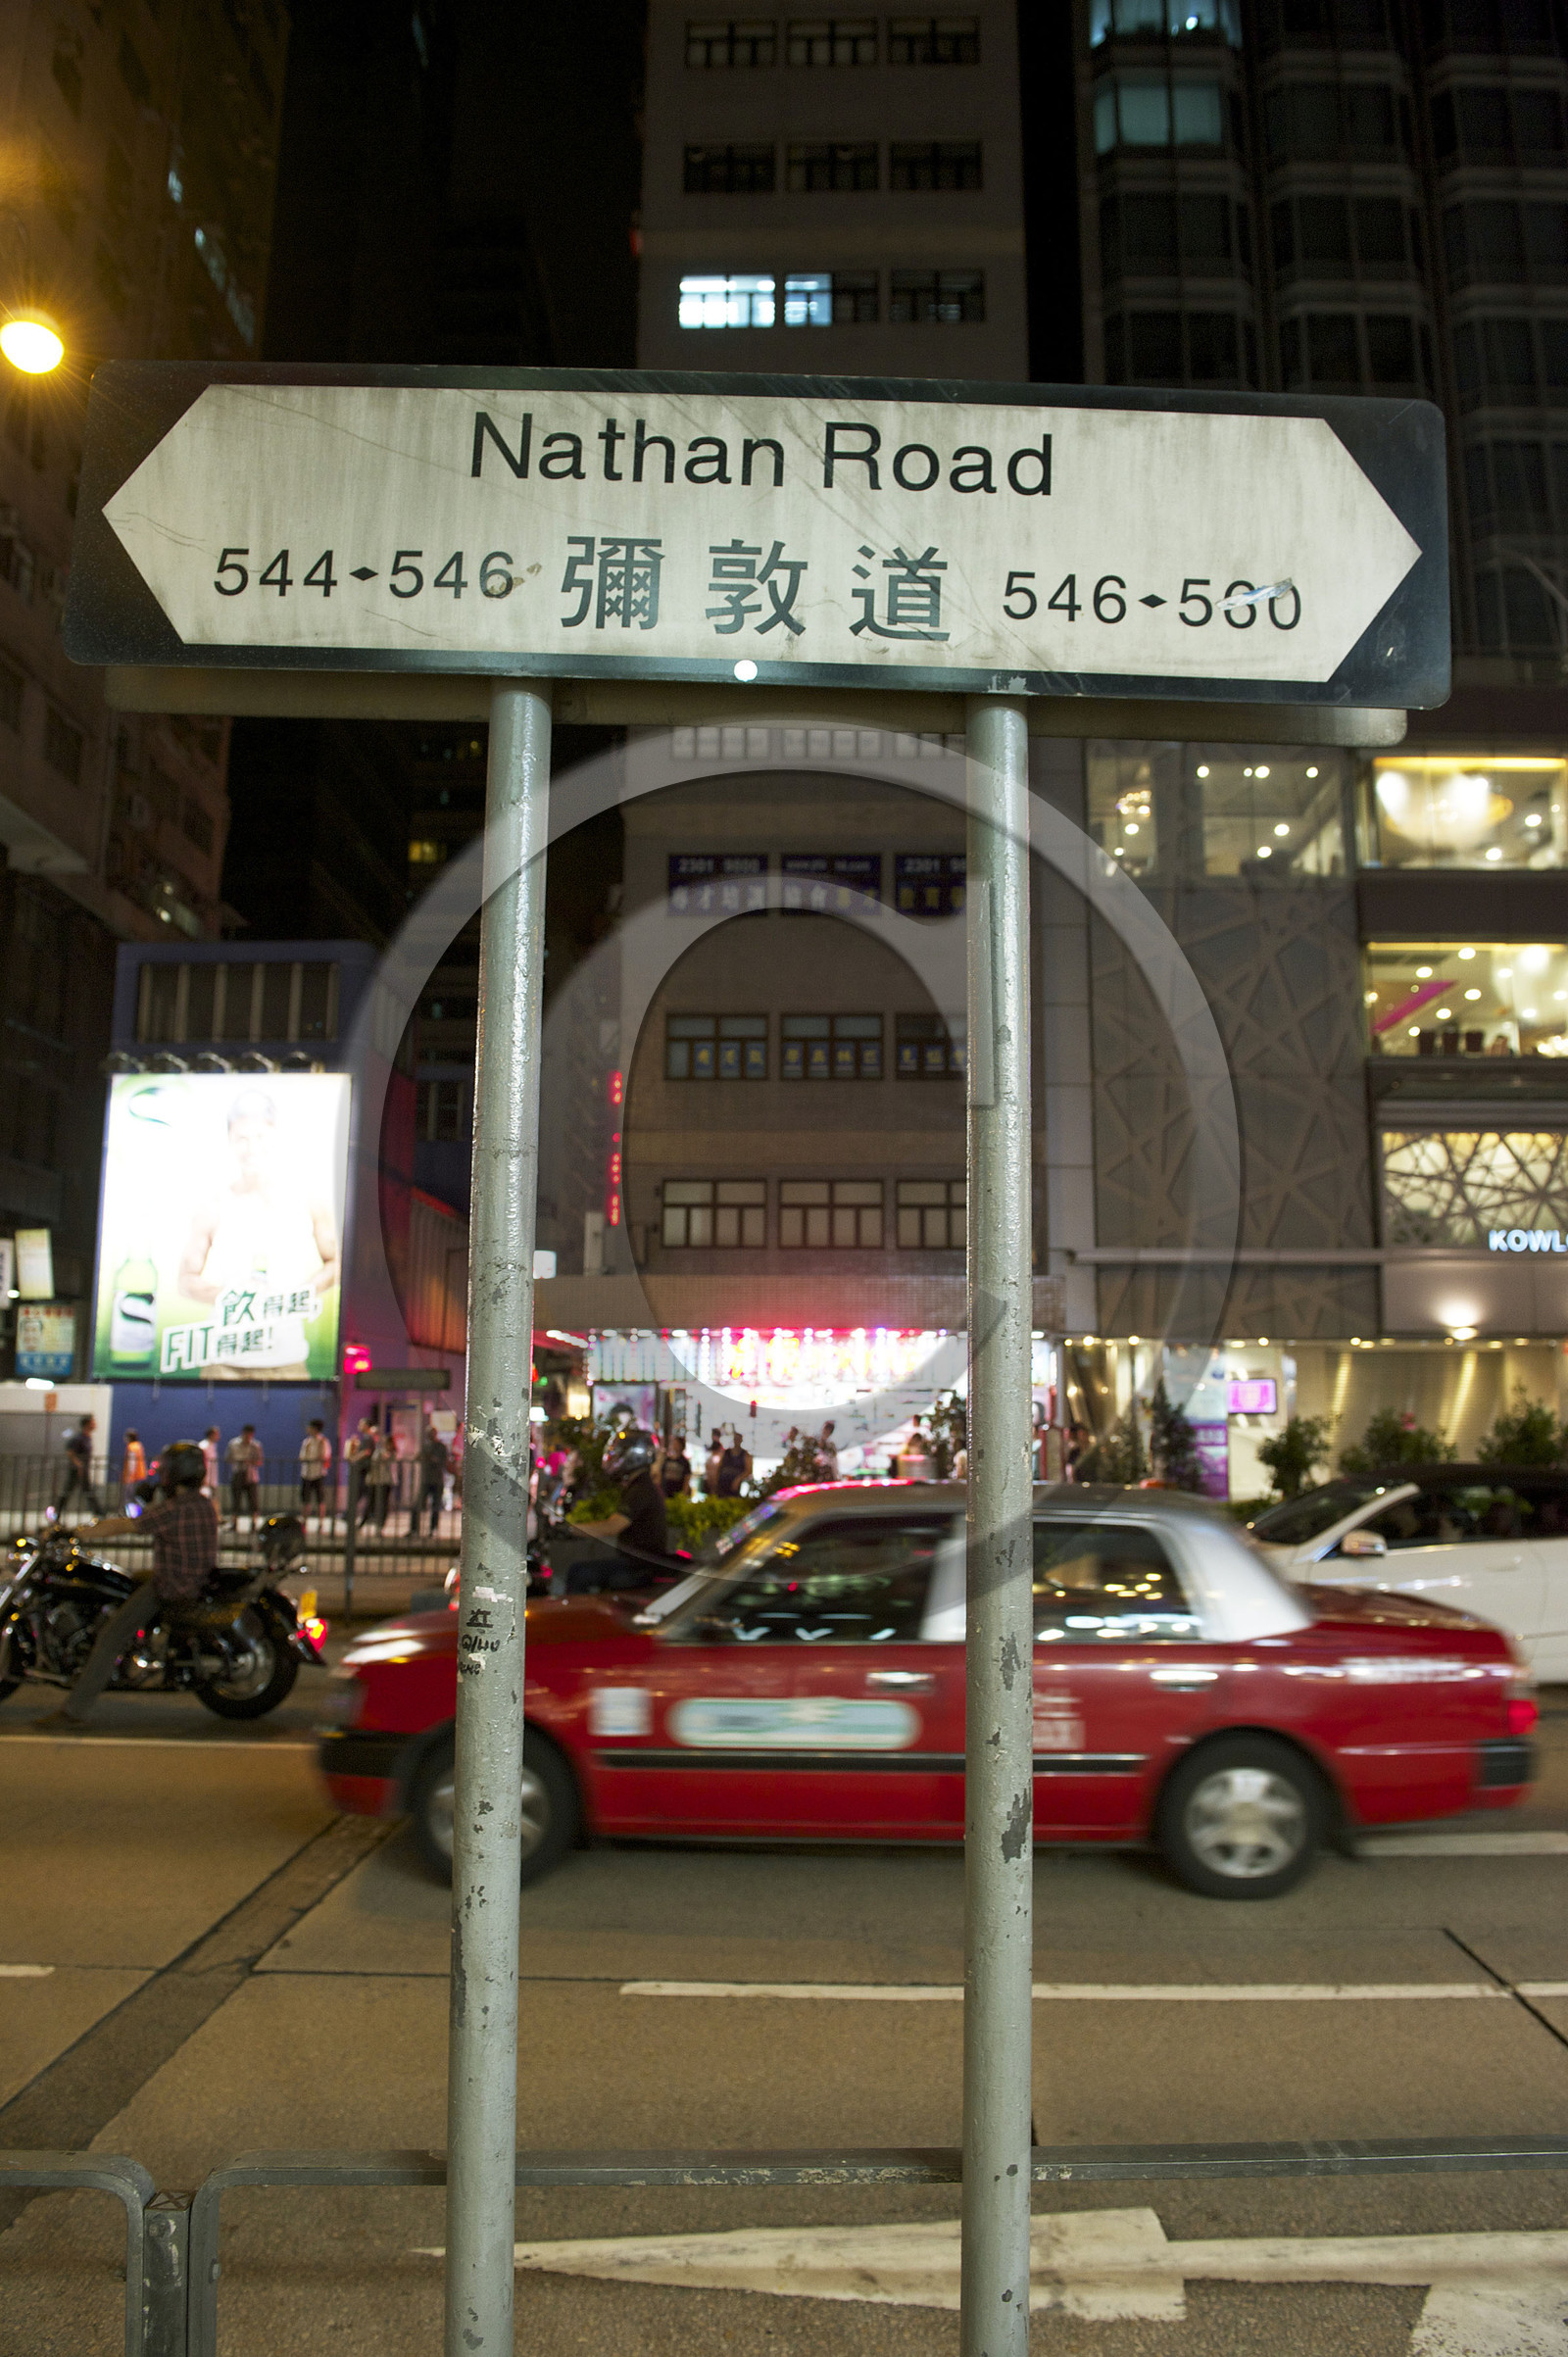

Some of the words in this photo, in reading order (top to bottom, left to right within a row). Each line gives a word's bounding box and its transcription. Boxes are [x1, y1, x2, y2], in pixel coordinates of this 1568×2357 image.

[469, 410, 786, 489] Nathan
[821, 420, 1054, 497] Road
[213, 546, 339, 599] 544
[388, 549, 516, 600] 546
[560, 535, 951, 643] 彌敦道
[1002, 570, 1128, 625] 546
[1488, 1228, 1568, 1253] KOWL
[166, 1326, 215, 1367] FIT
